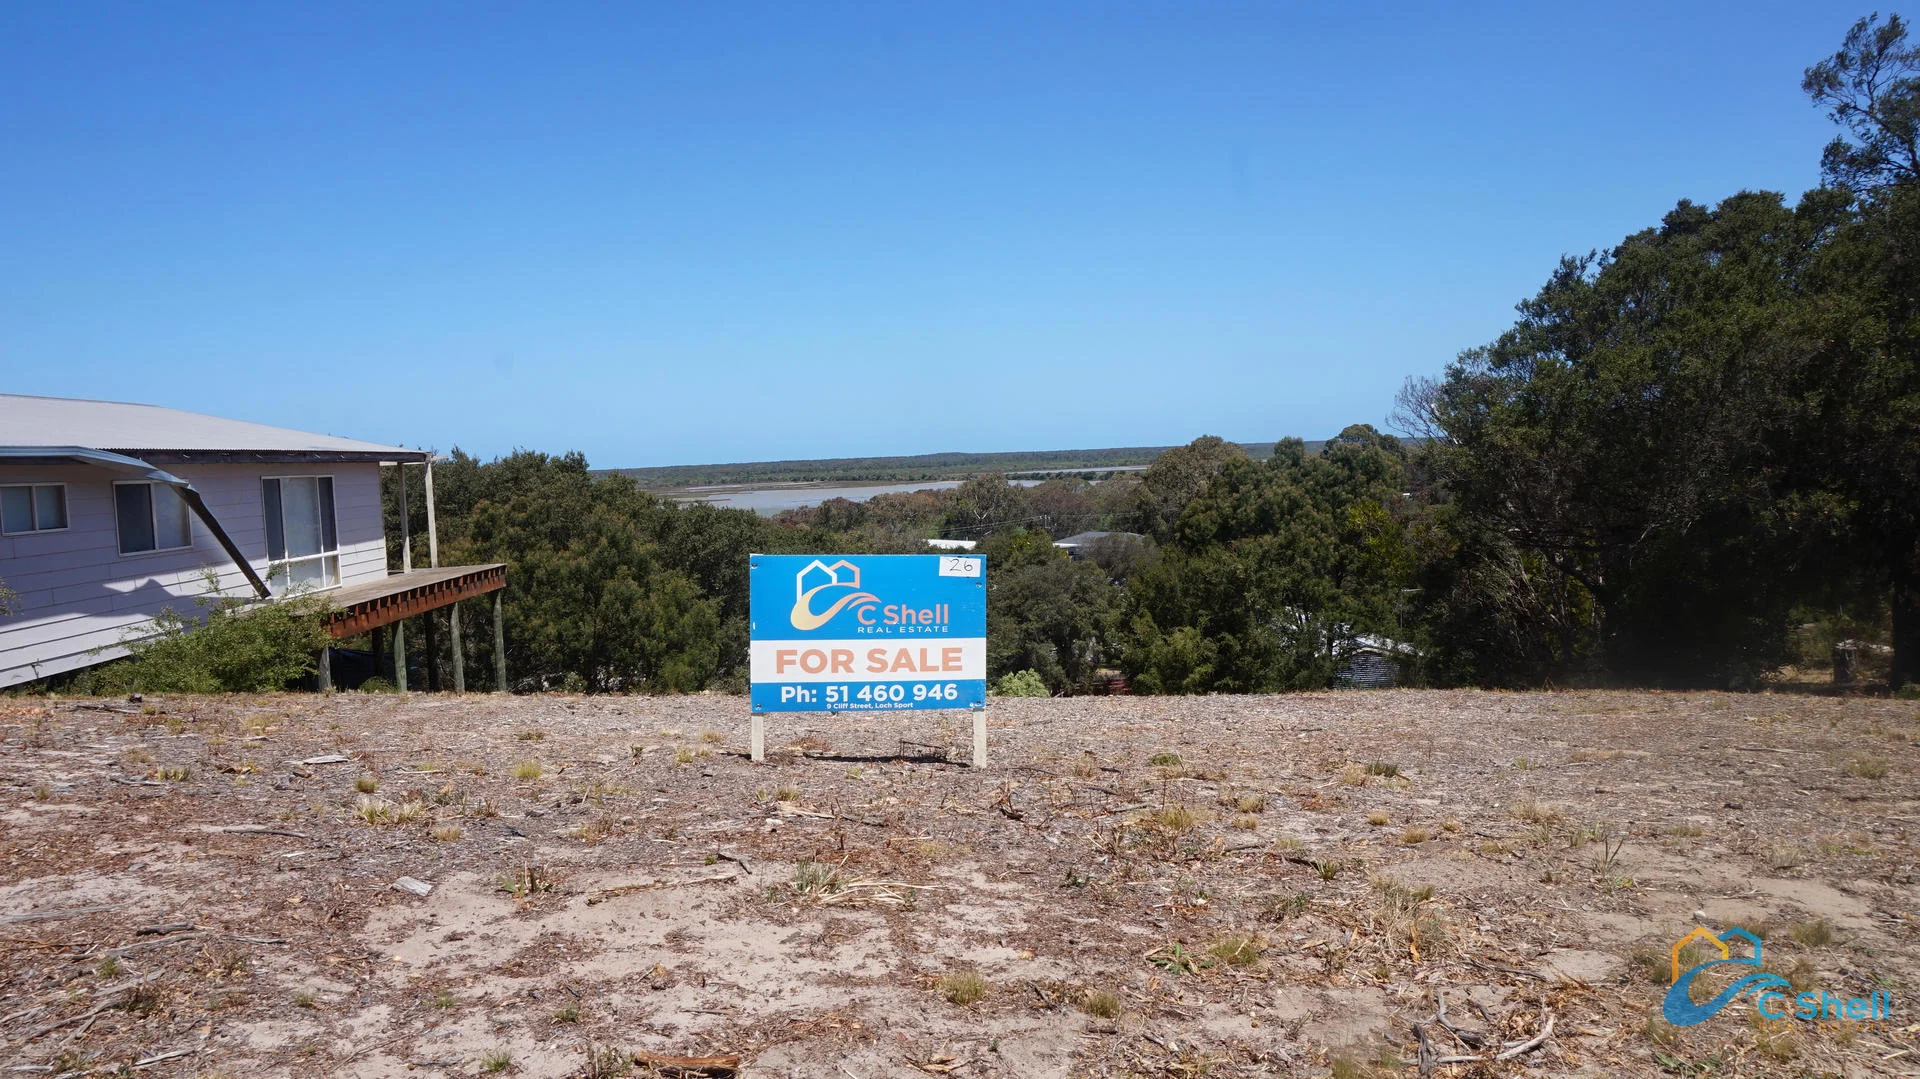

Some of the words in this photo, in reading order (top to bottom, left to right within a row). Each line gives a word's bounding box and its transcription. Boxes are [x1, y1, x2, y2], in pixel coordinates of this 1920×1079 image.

[948, 558, 974, 572] 26
[857, 605, 876, 625] C
[883, 604, 949, 625] Shell
[776, 648, 855, 674] FOR
[866, 647, 963, 673] SALE
[781, 686, 817, 703] Ph:
[825, 685, 848, 702] 51
[856, 684, 905, 702] 460
[912, 683, 959, 701] 946
